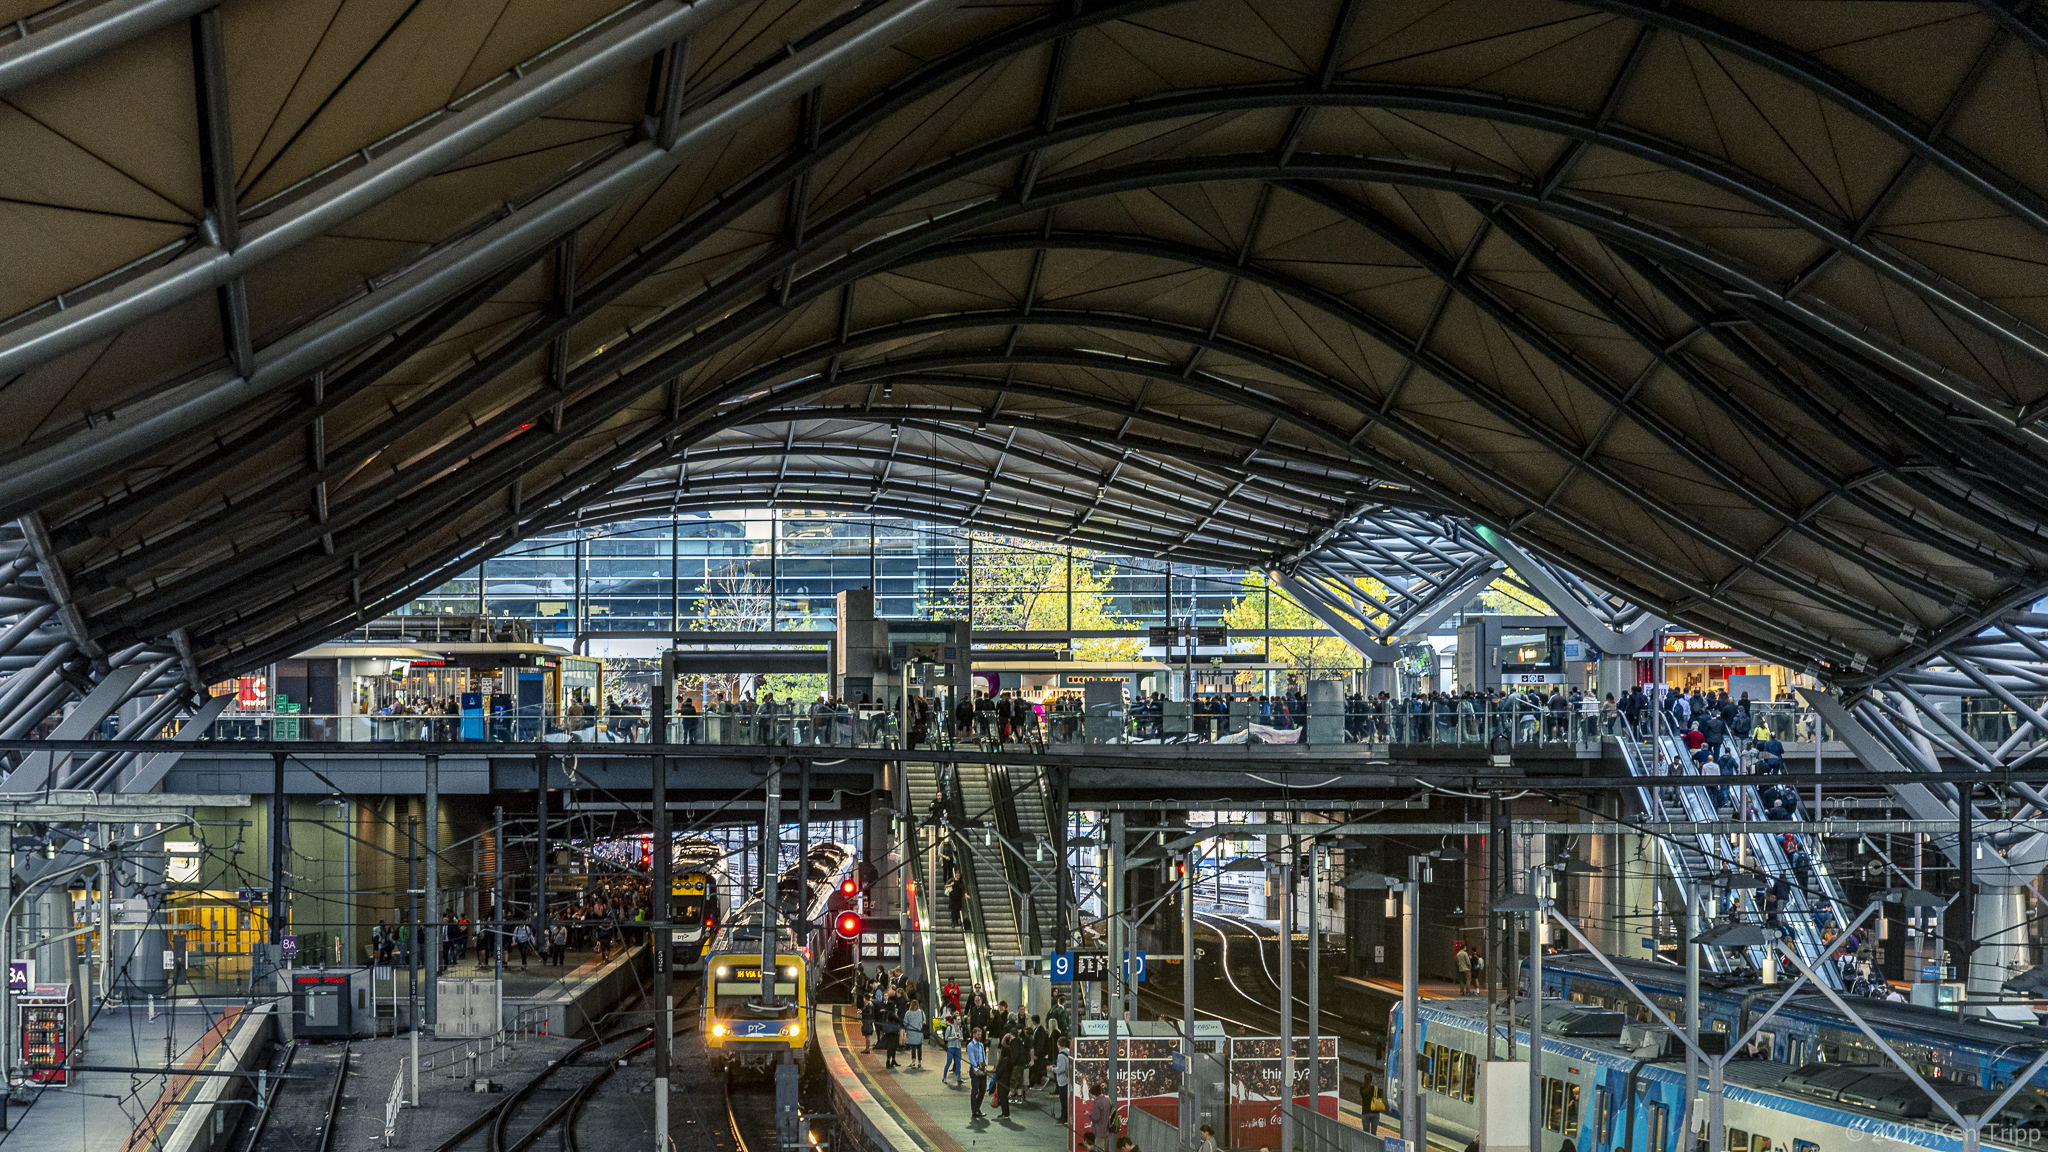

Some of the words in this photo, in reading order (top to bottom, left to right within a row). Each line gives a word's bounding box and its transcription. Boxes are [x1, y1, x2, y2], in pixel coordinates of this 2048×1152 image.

[1686, 638, 1703, 650] red
[1067, 676, 1094, 685] SUGAR
[283, 939, 295, 949] 8A
[1056, 956, 1069, 975] 9
[1123, 956, 1144, 975] 10
[745, 970, 756, 978] VIA
[1262, 1068, 1311, 1081] thirty?
